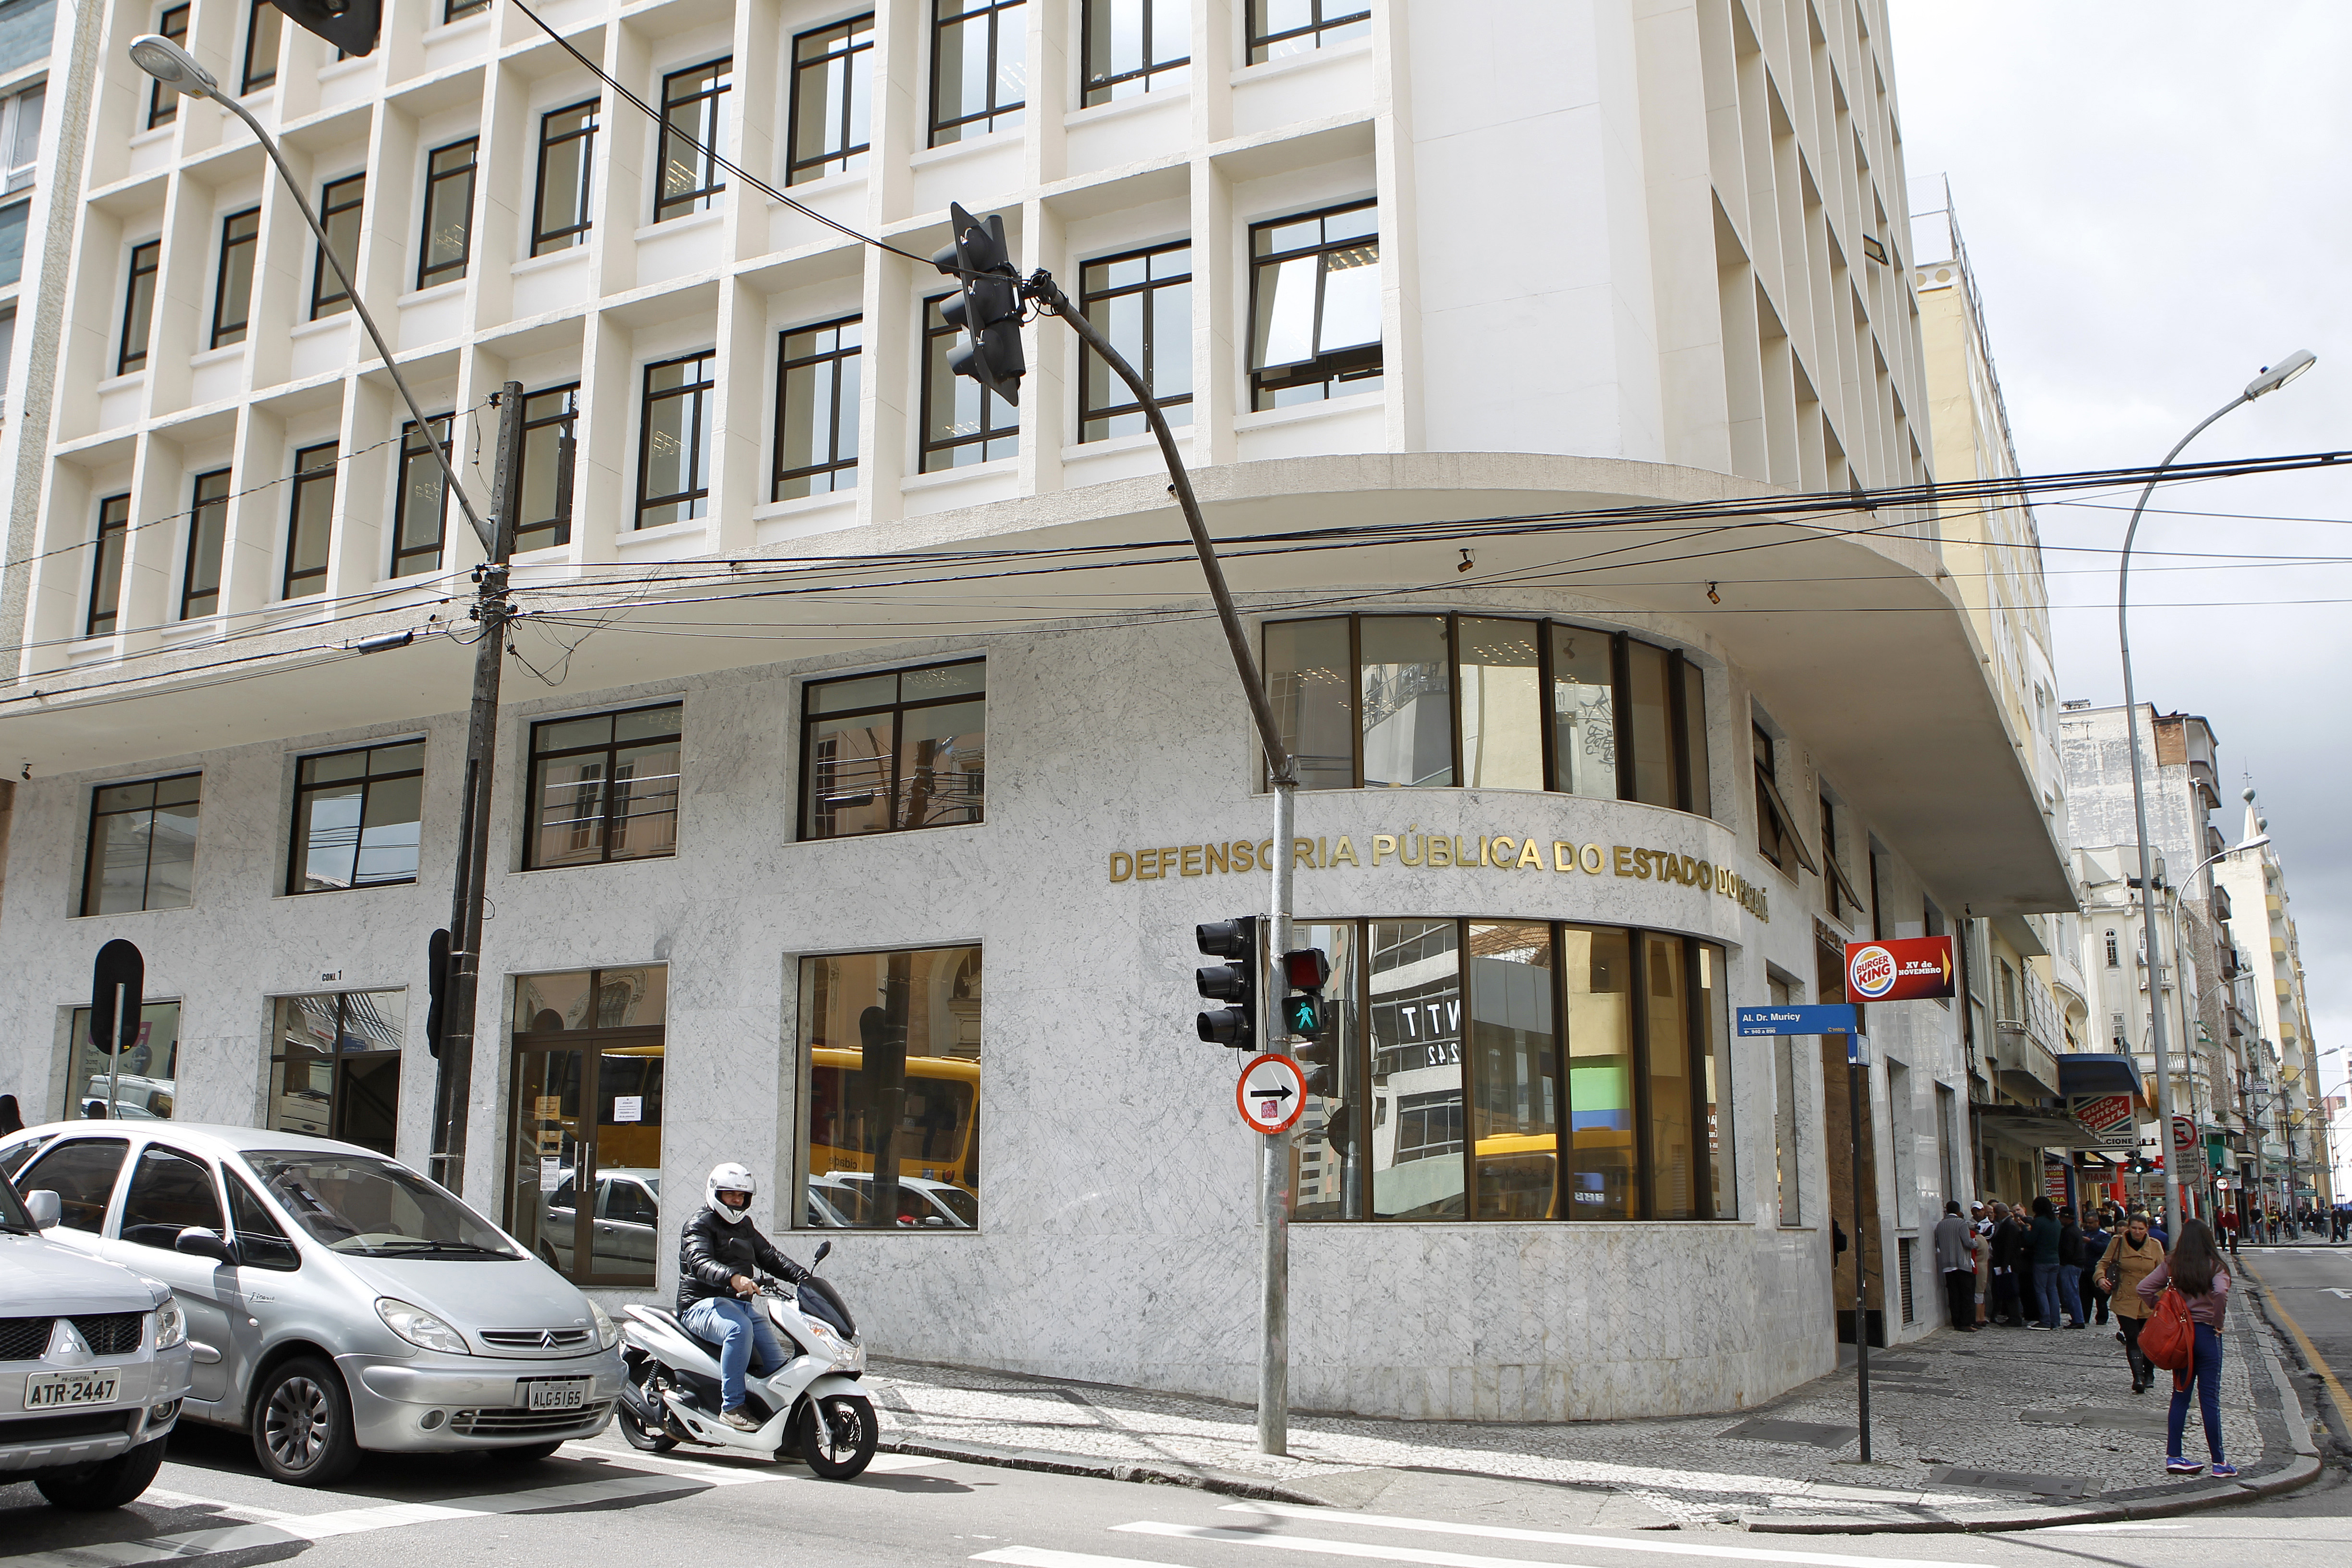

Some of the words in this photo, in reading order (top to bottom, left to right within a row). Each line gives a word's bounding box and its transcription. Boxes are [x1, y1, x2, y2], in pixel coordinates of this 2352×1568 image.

[1109, 835, 1360, 882] DEFENSORIA
[1372, 823, 1544, 870] PÚBLICA
[1552, 841, 1605, 874] DO
[1613, 845, 1714, 890] ESTADO
[1715, 864, 1737, 898] DO
[1736, 874, 1770, 923] PARANÁ
[338, 969, 342, 980] 1
[1856, 956, 1889, 975] BURGER
[1898, 967, 1942, 976] NOVEMBRO
[1858, 963, 1891, 987] KING
[1770, 1013, 1801, 1022] Muricy
[2083, 1099, 2113, 1117] auto
[2094, 1108, 2126, 1130] park
